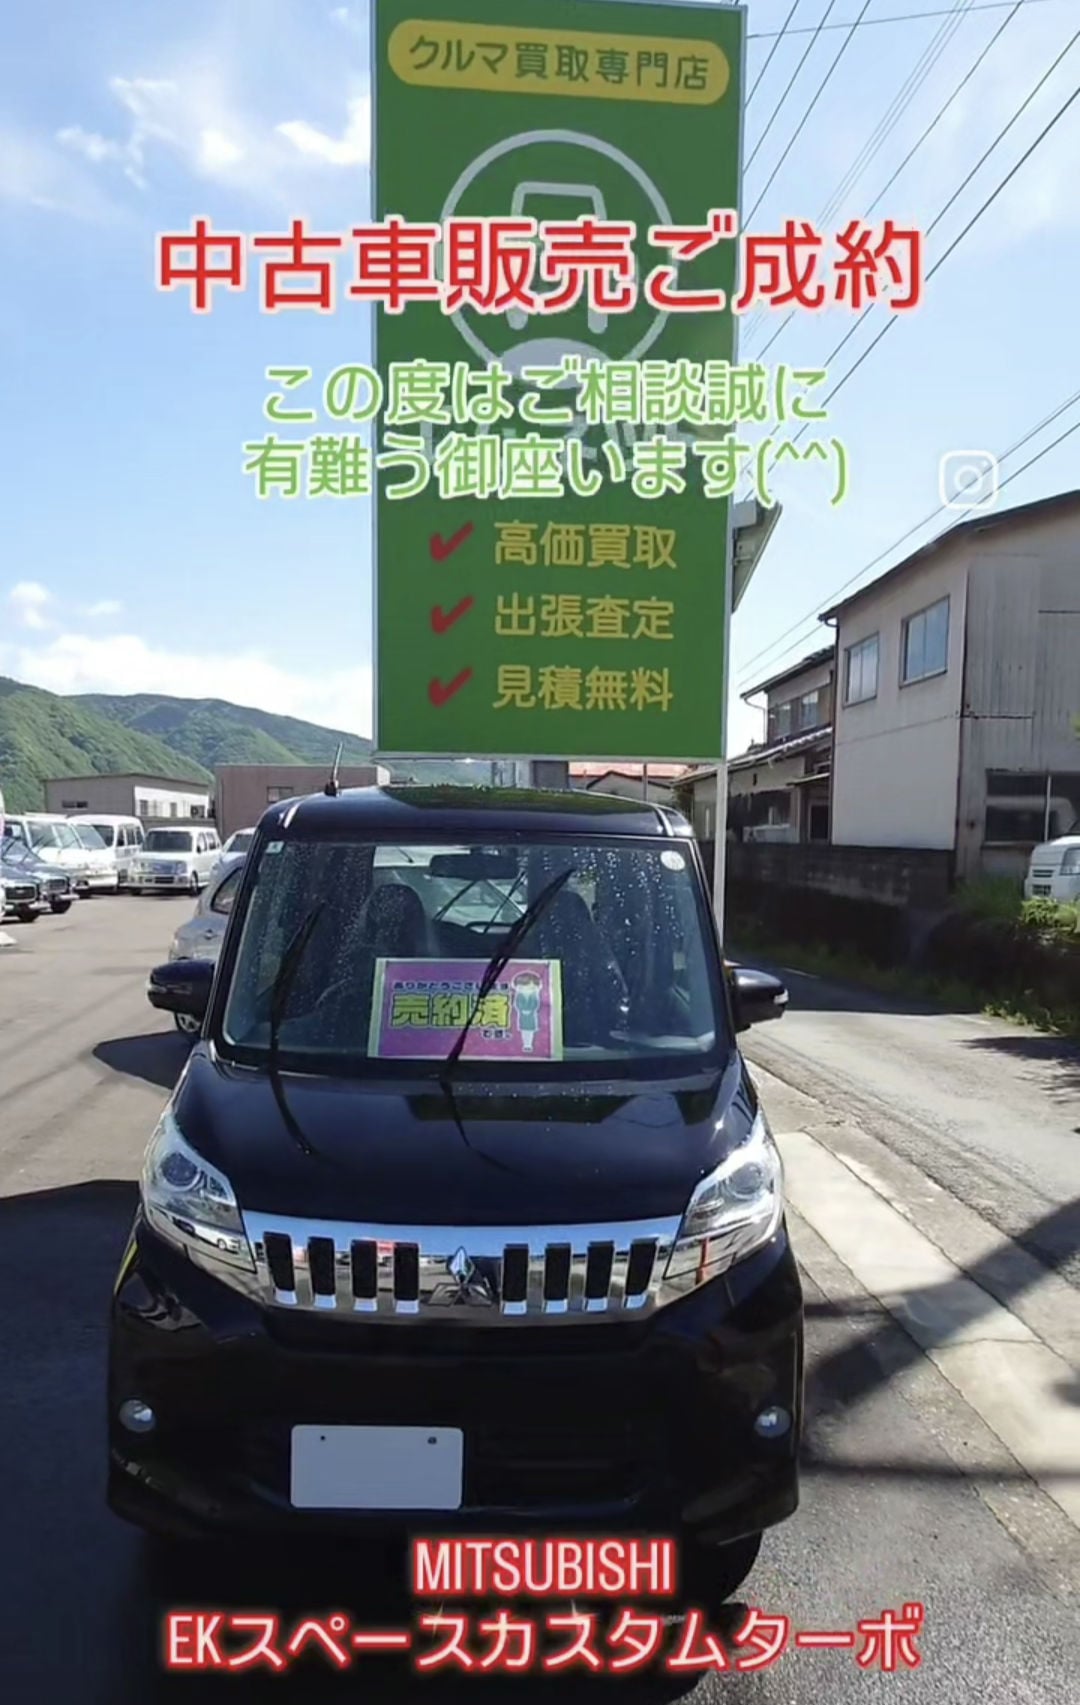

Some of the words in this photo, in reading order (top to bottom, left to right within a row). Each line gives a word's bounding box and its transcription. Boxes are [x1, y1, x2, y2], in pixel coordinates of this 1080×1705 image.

[408, 34, 710, 91] クルマ買取専門店
[493, 518, 678, 570] 高価買取
[494, 591, 675, 640] 出張査定
[491, 663, 674, 723] 見積無料
[390, 992, 511, 1027] 売約済
